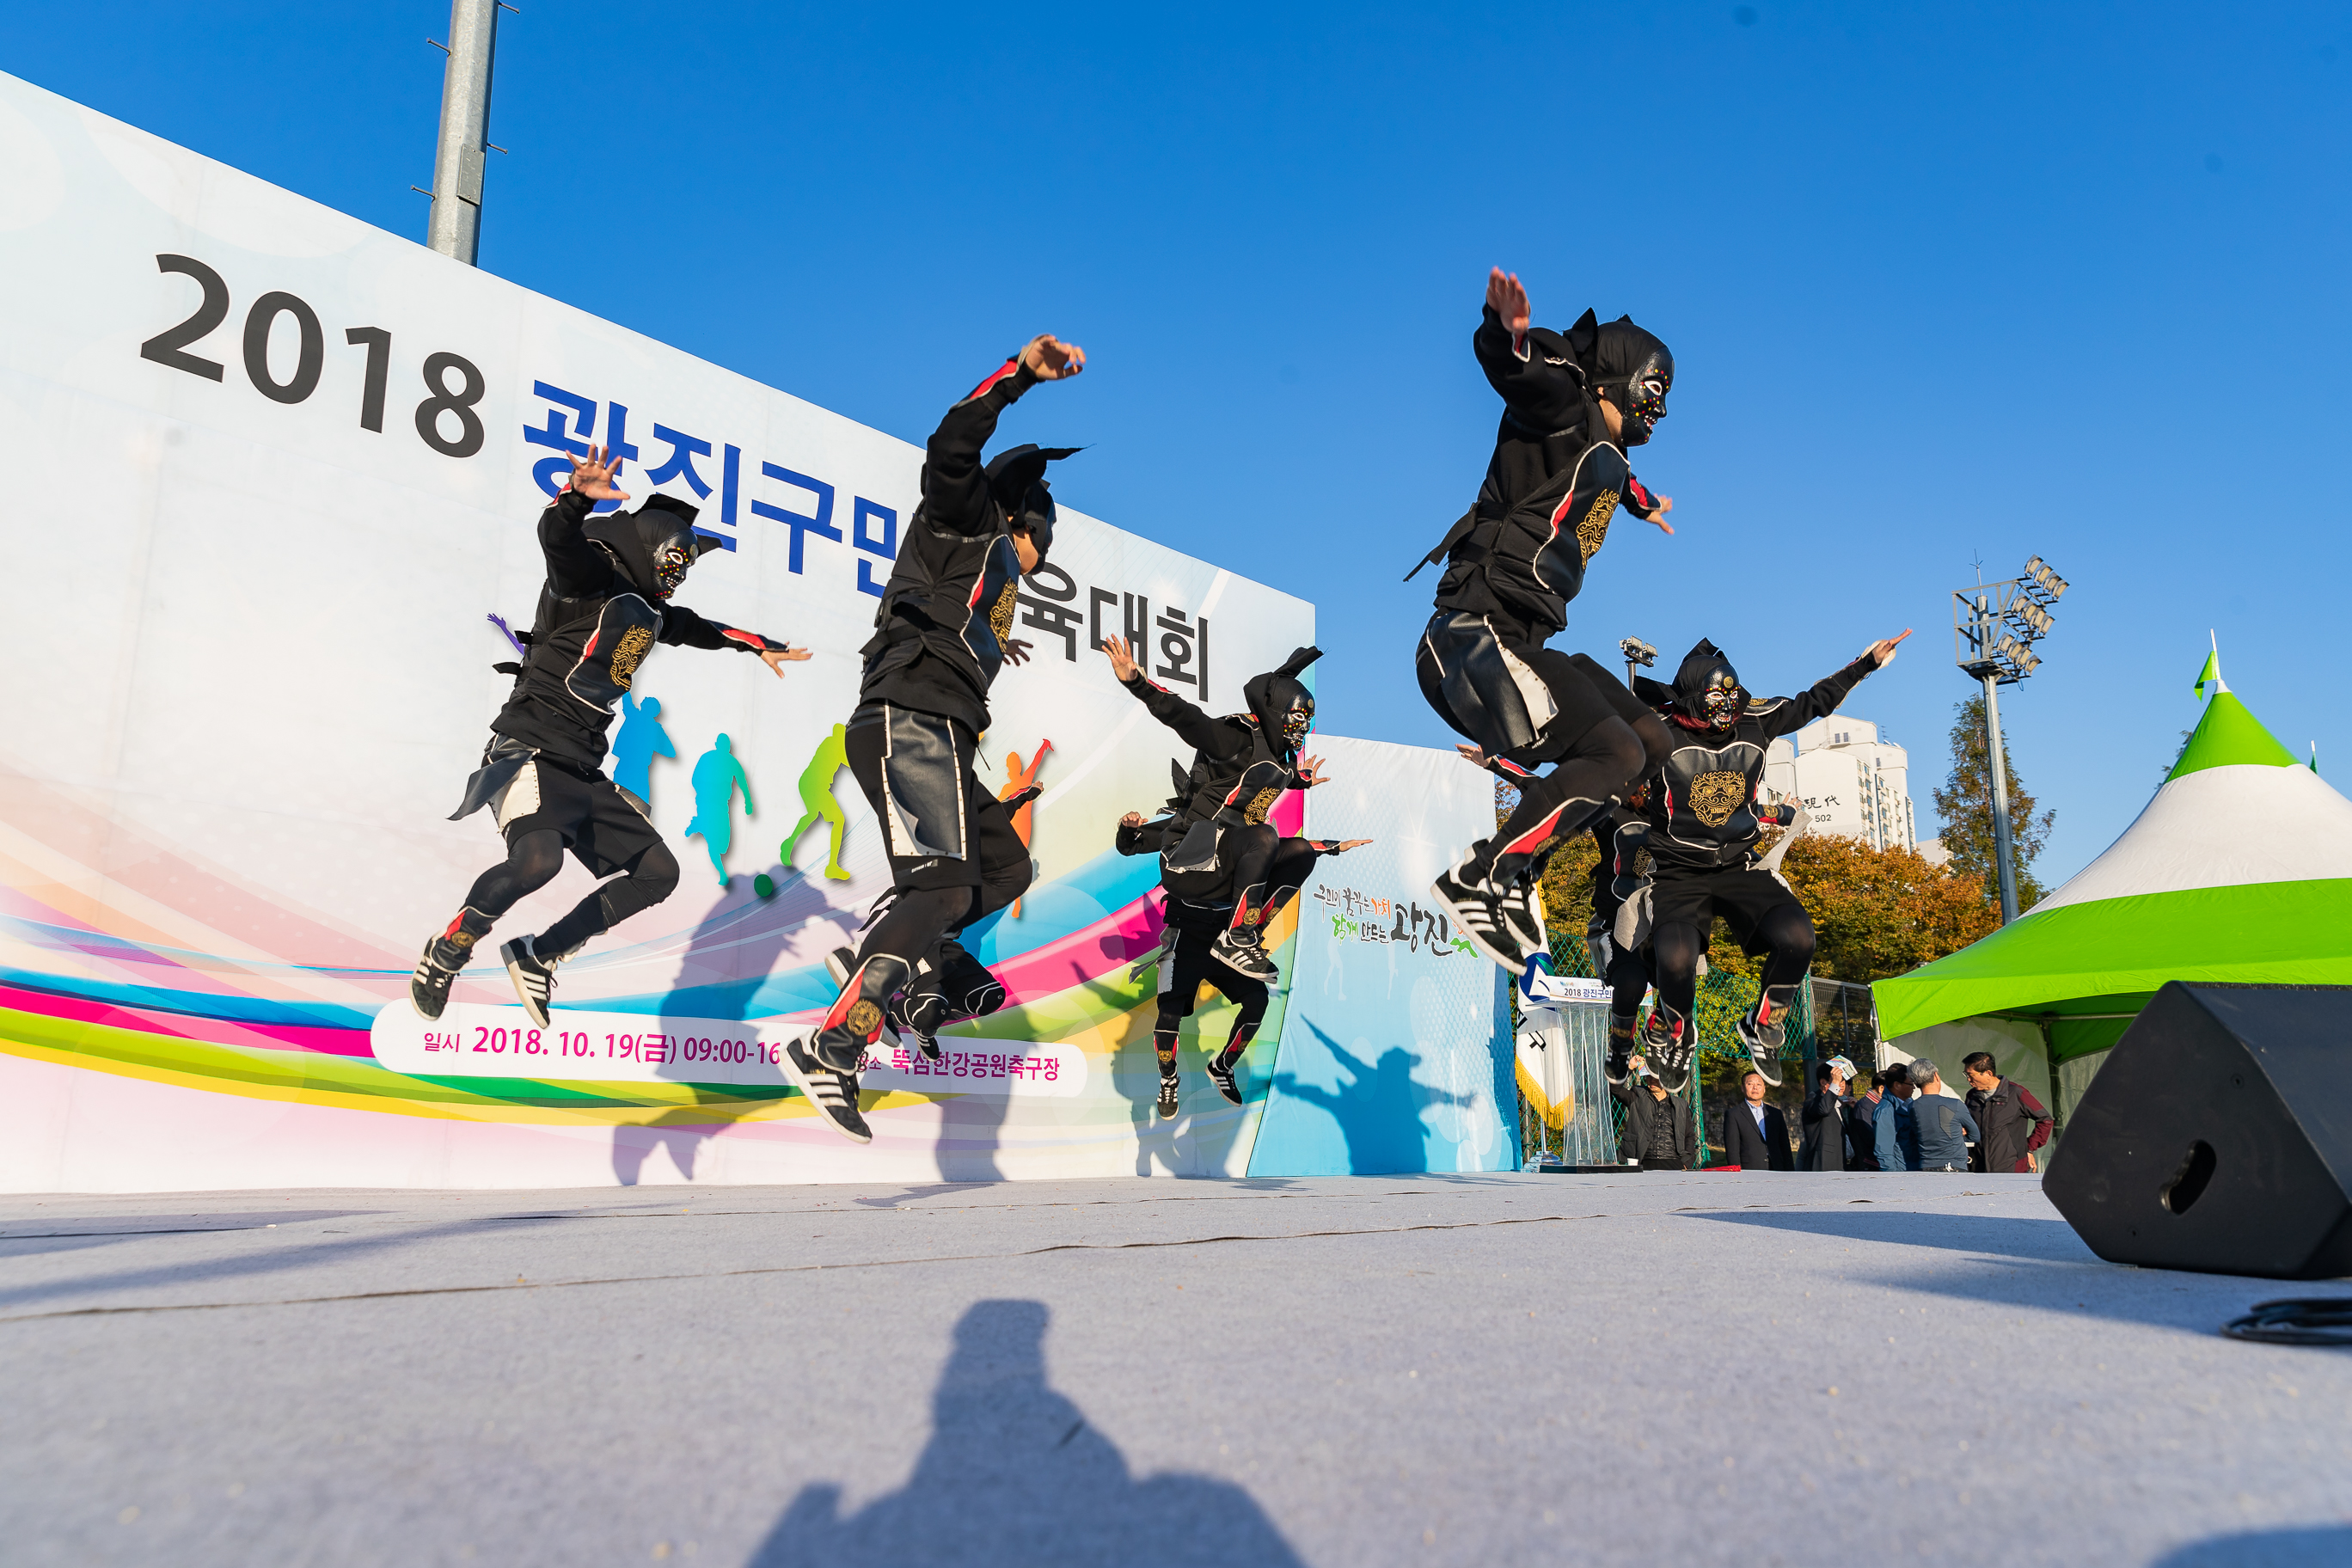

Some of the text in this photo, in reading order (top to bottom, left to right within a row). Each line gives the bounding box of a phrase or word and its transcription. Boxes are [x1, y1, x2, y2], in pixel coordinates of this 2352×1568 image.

[140, 254, 486, 458] 2018
[1016, 561, 1209, 702] 육대회
[1815, 814, 1832, 823] 502
[1332, 901, 1453, 956] 함께 만드는 광진
[1564, 988, 1582, 996] 2018
[424, 1032, 461, 1053] 일시
[473, 1026, 548, 1055] 2018.
[559, 1032, 595, 1057] 10.
[605, 1034, 677, 1065] 19(금)
